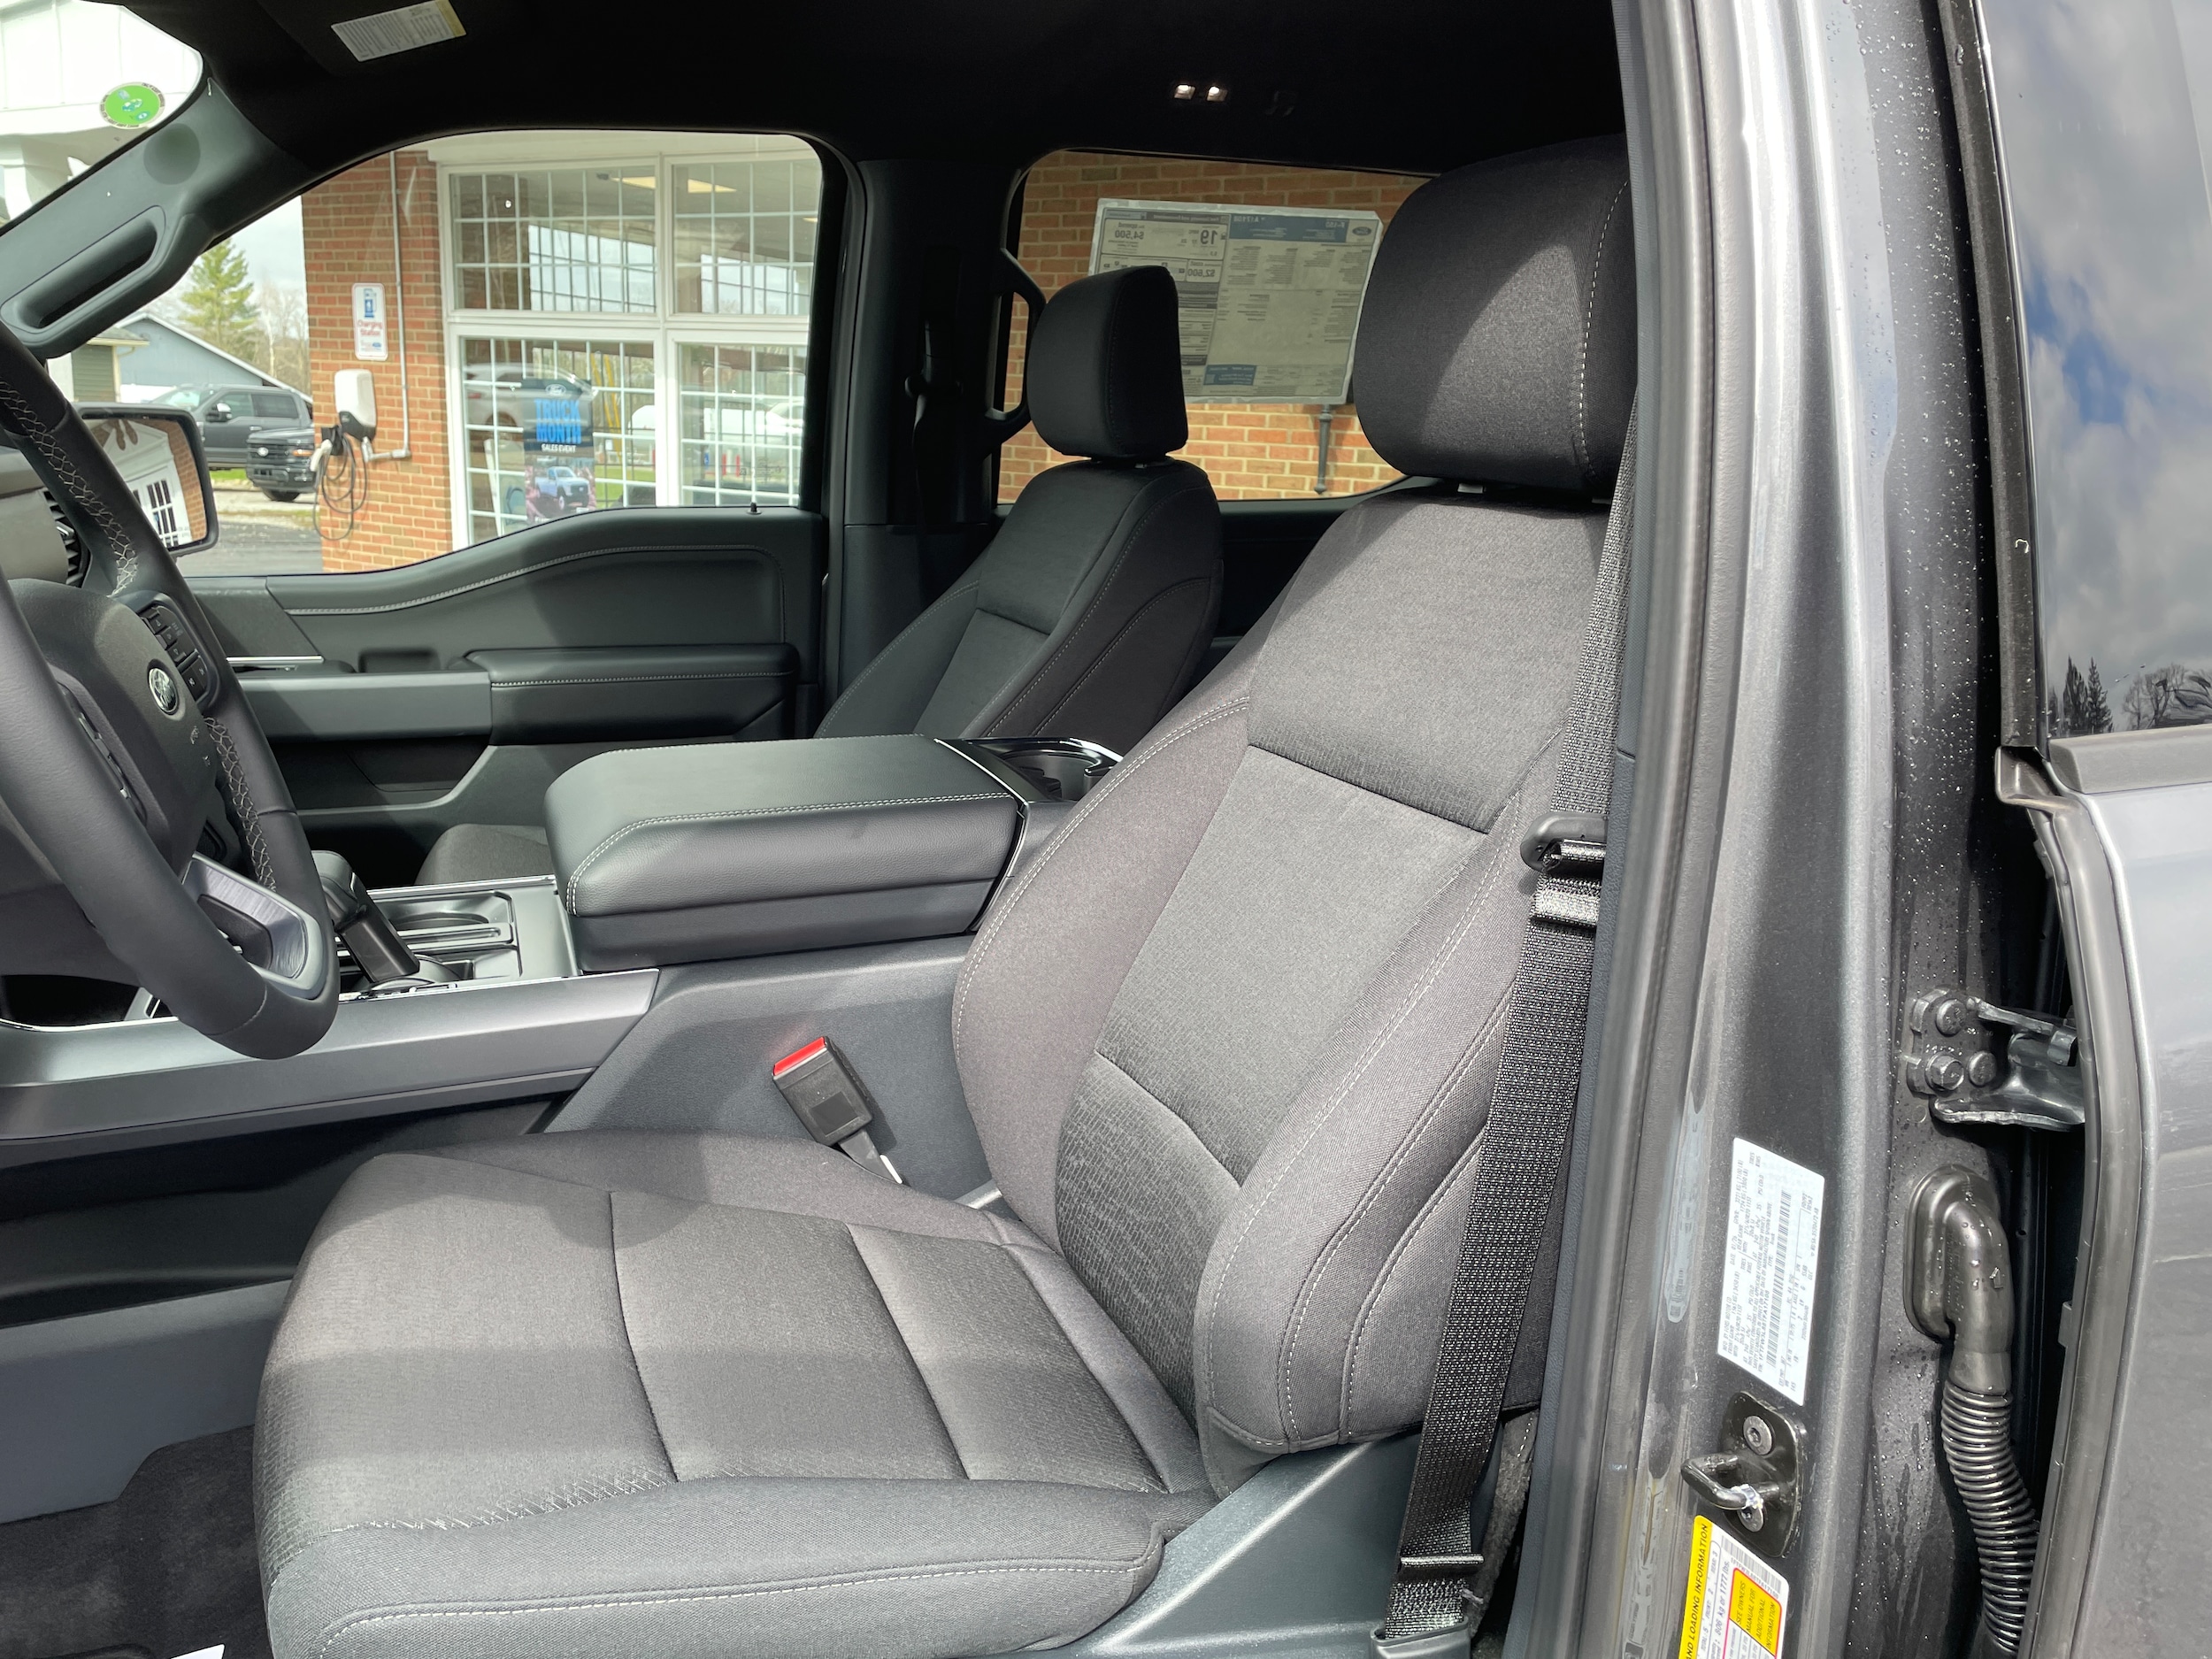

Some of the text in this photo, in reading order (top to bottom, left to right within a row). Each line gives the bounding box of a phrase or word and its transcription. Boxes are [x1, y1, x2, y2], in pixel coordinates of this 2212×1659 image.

[357, 319, 382, 329] Charging
[534, 399, 580, 421] TRUCK
[536, 422, 582, 443] MONTH
[559, 444, 576, 453] EVENT
[1694, 1523, 1709, 1594] INFORMATION
[1719, 1573, 1728, 1595] 1777
[1719, 1595, 1725, 1606] or
[1738, 1580, 1747, 1611] OWNERS
[1688, 1595, 1701, 1641] LOADING
[1717, 1606, 1725, 1617] kg
[1746, 1604, 1755, 1633] MANUAL
[1755, 1599, 1766, 1640] ADDITIONAL
[1765, 1601, 1776, 1650] INFORMATION
